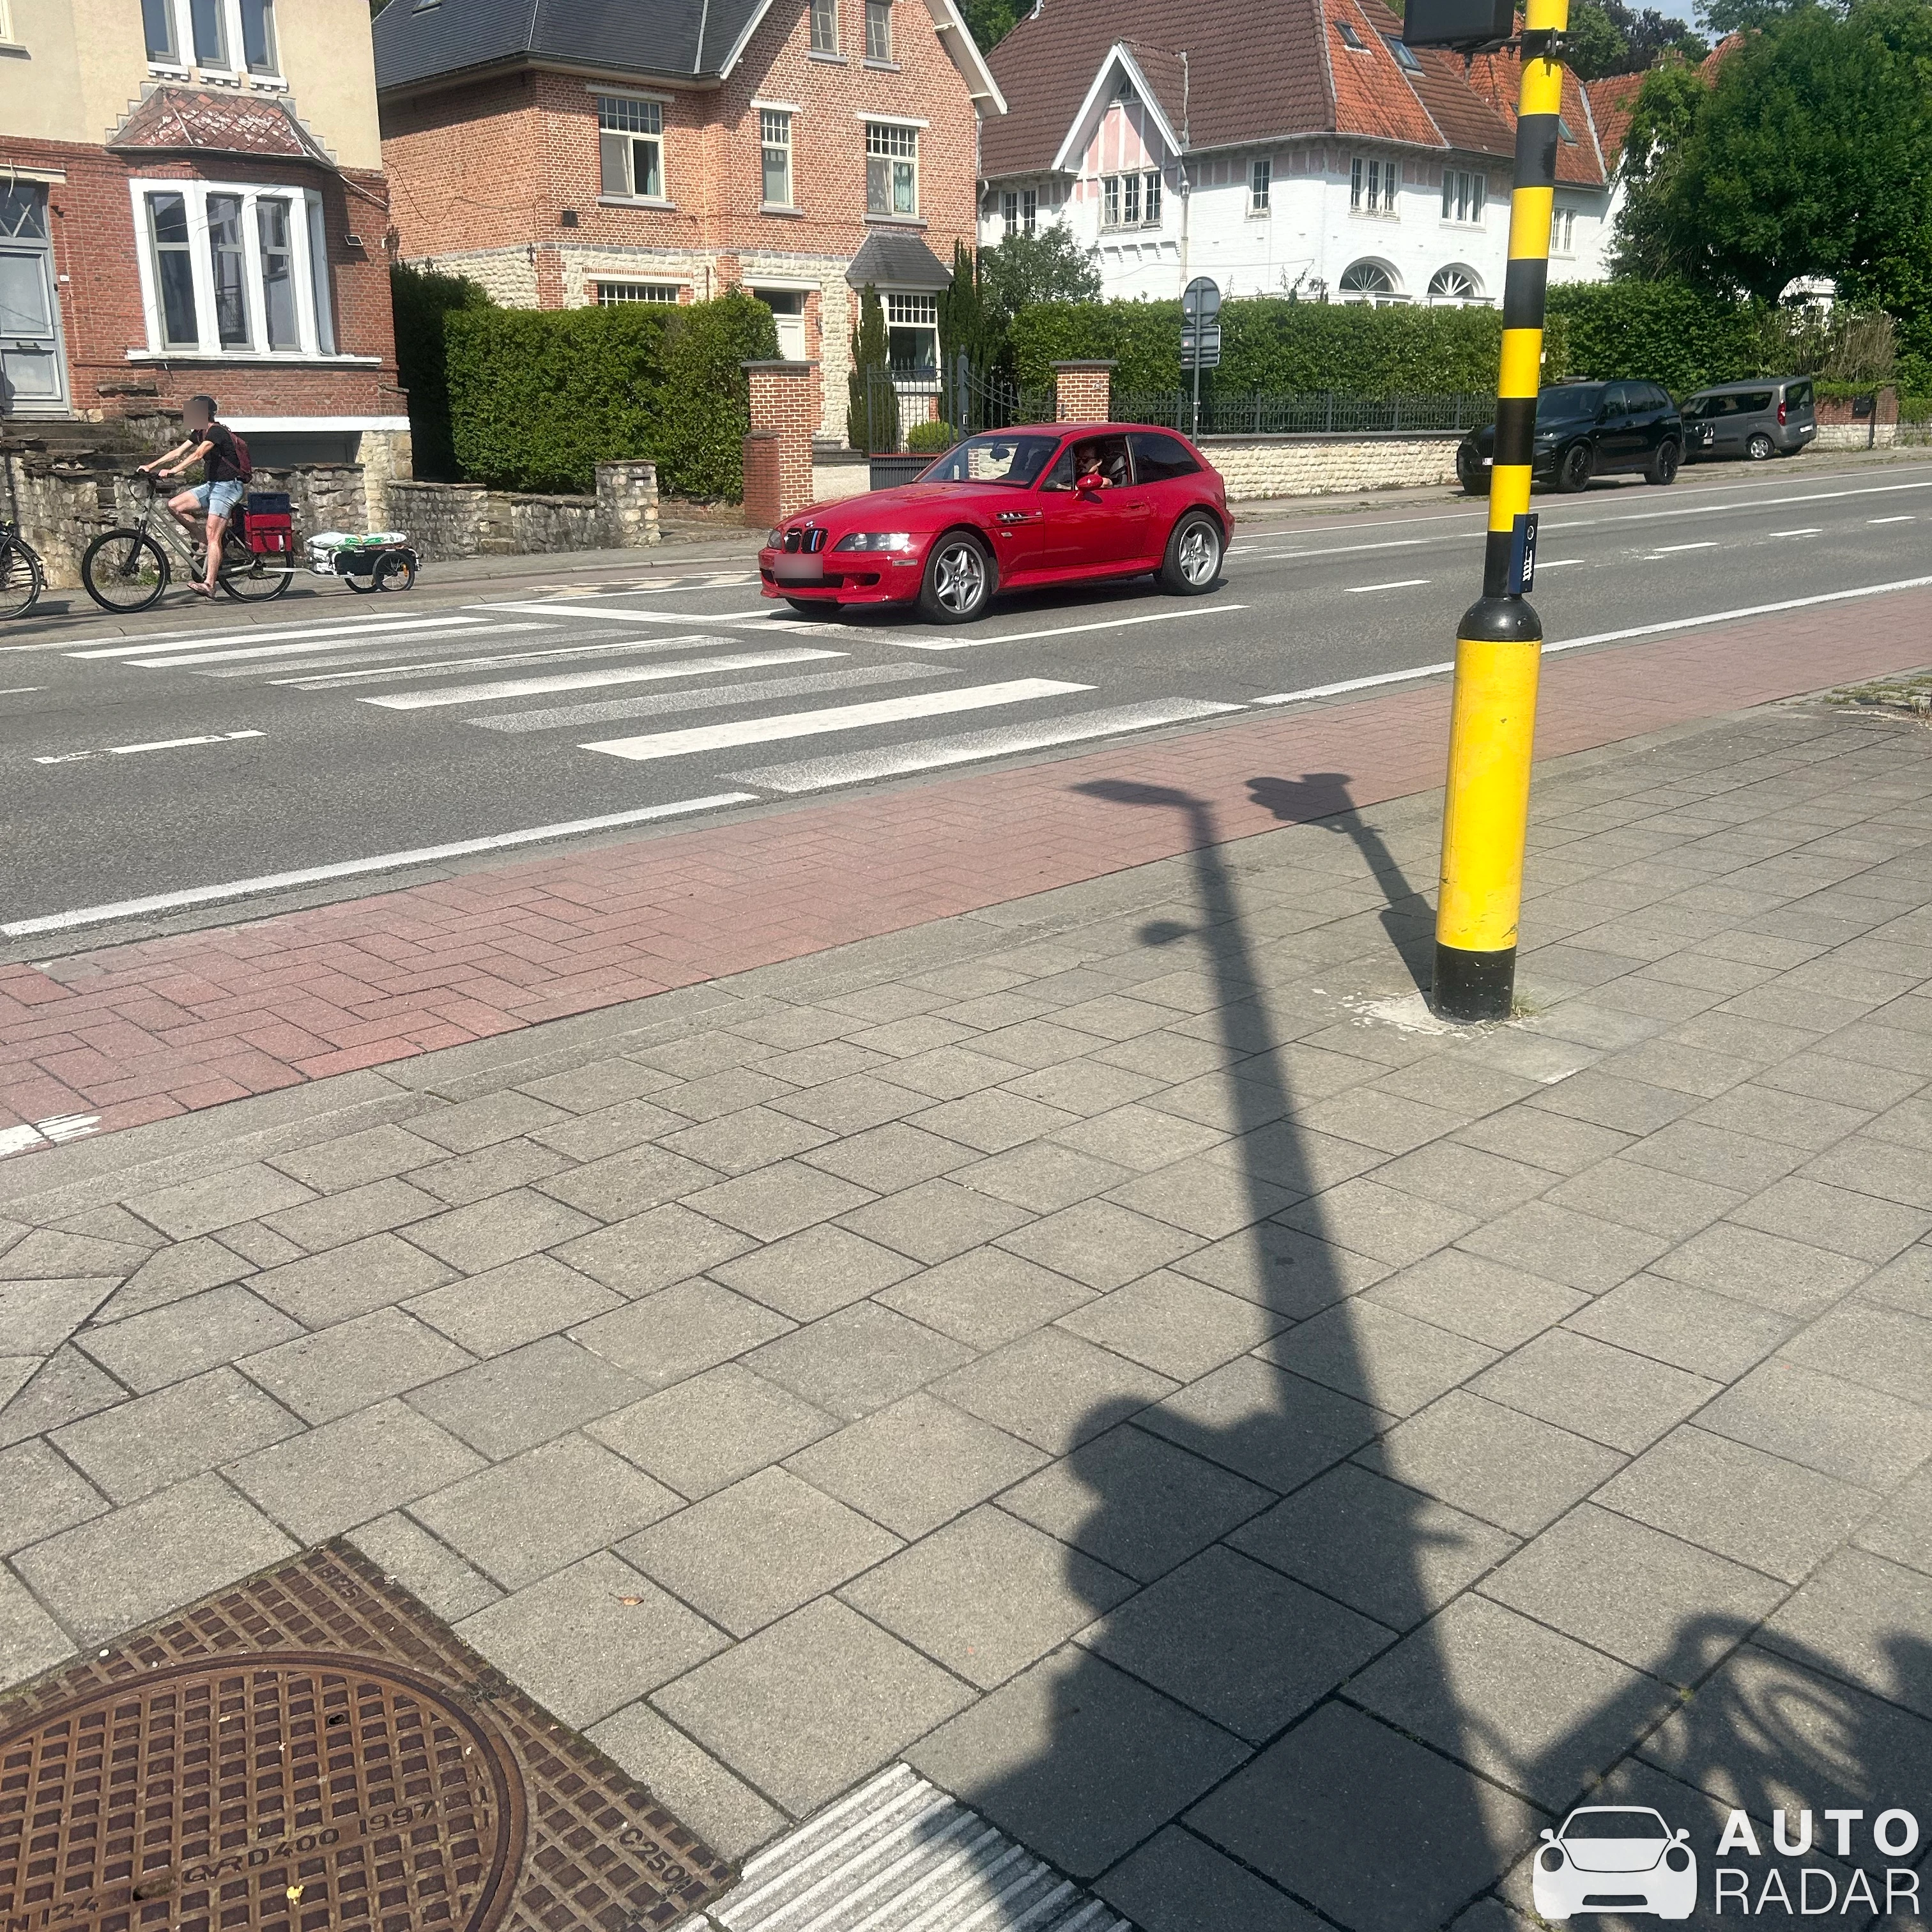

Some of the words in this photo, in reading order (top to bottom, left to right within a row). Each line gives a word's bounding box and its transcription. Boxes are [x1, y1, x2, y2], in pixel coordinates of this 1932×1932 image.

[41, 1896, 99, 1926] 124
[183, 1855, 243, 1883] GVR
[248, 1828, 340, 1867] D400
[360, 1800, 437, 1836] 1997
[619, 1828, 686, 1883] C250
